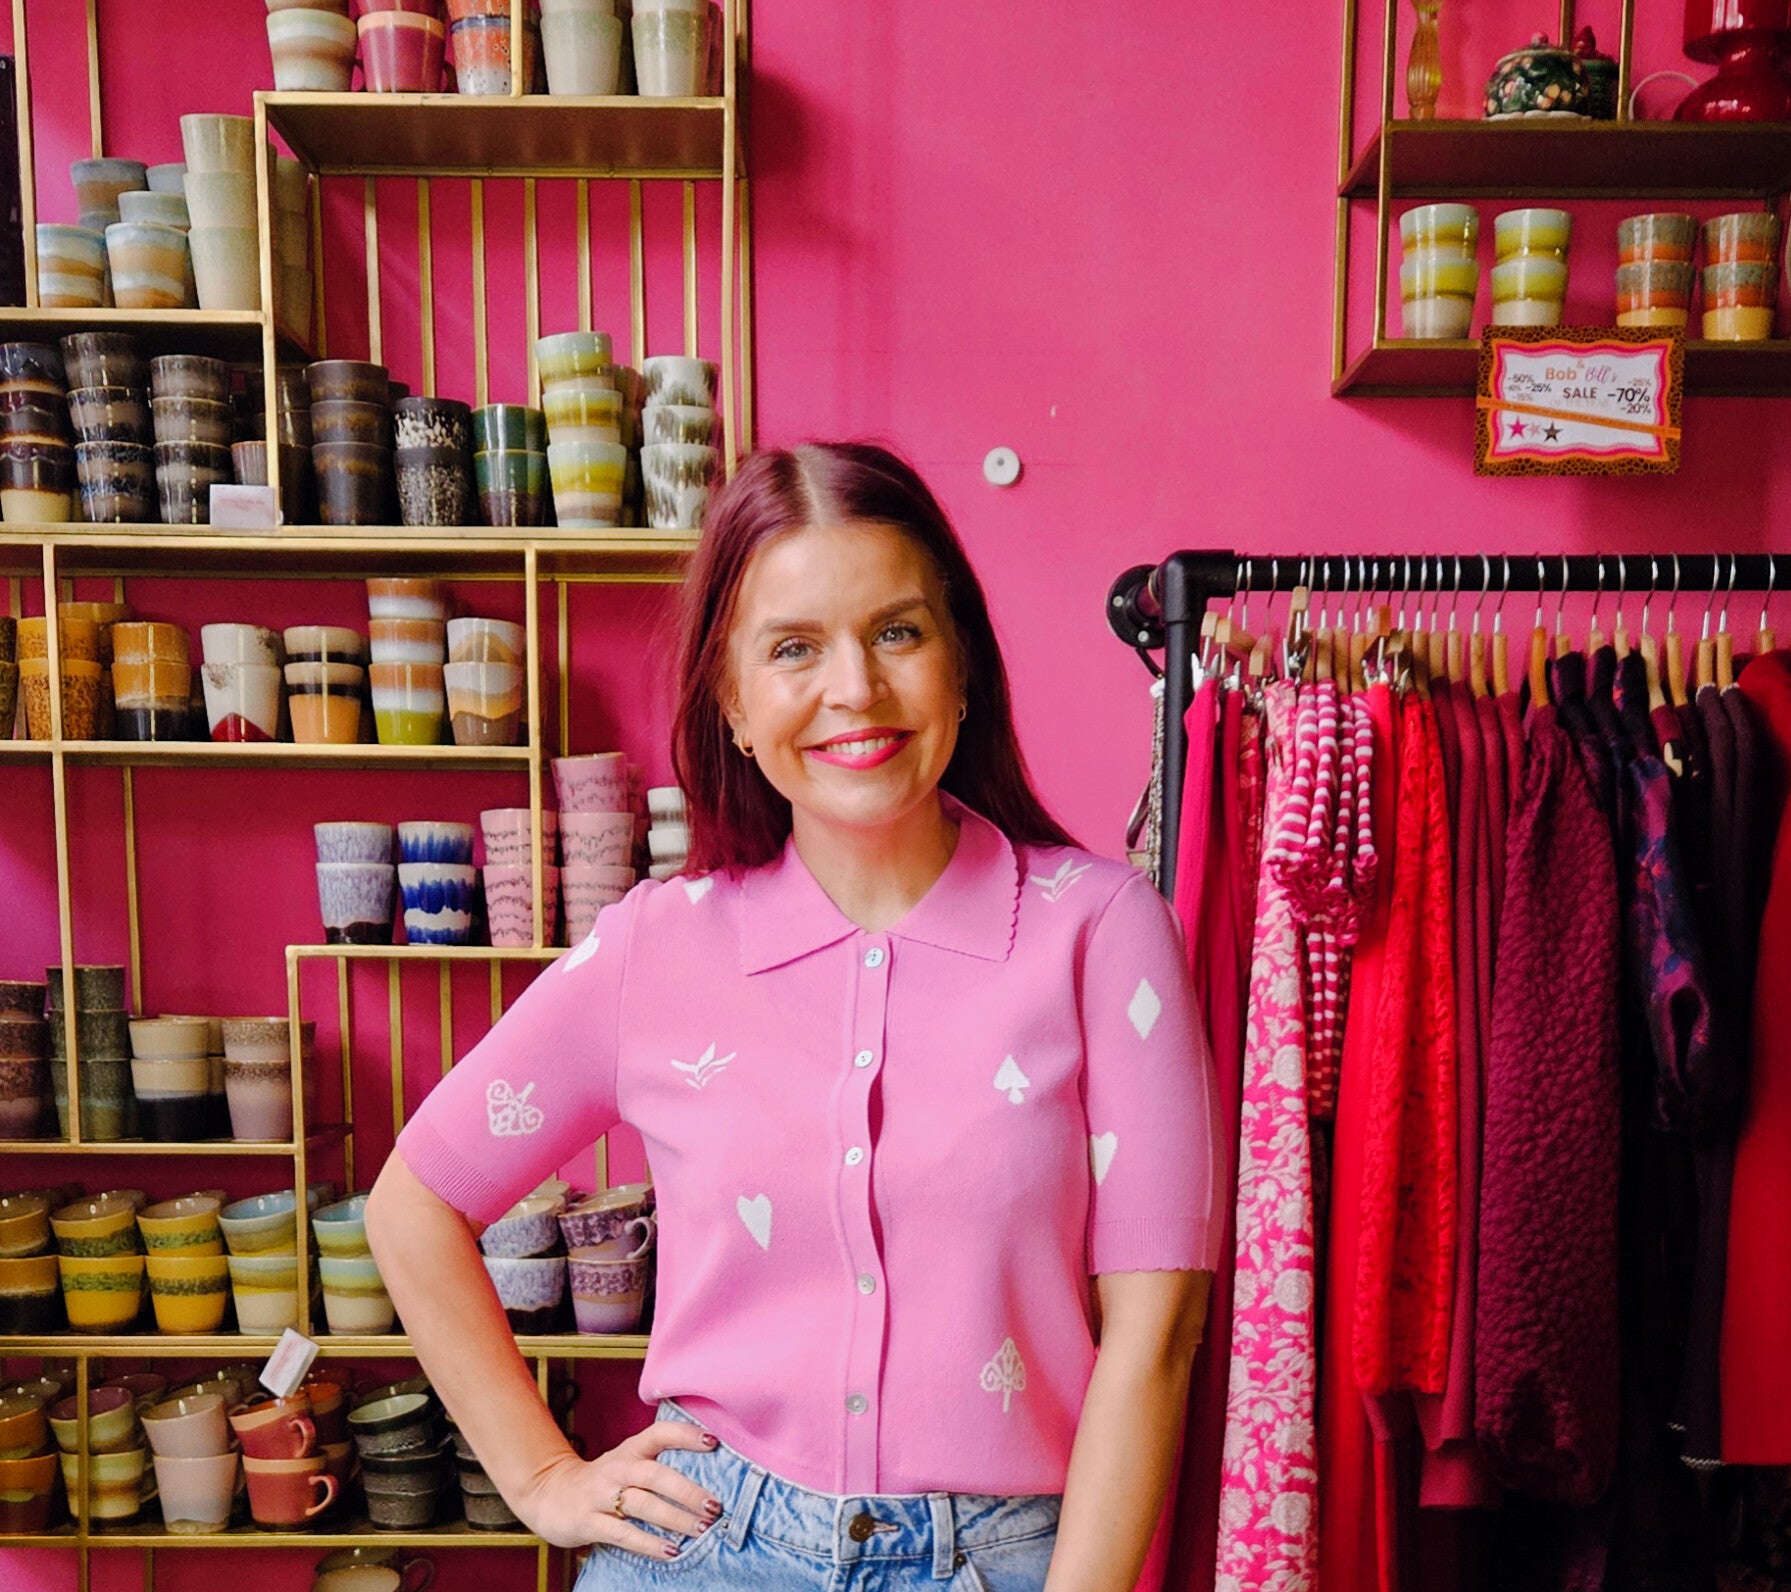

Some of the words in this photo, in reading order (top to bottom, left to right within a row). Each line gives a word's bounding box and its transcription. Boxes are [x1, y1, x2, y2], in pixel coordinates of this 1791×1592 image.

[1545, 367, 1577, 380] Bob
[1526, 382, 1552, 393] -25%
[1563, 387, 1598, 399] SALE
[1607, 387, 1651, 402] -70%
[1620, 402, 1652, 414] -20%
